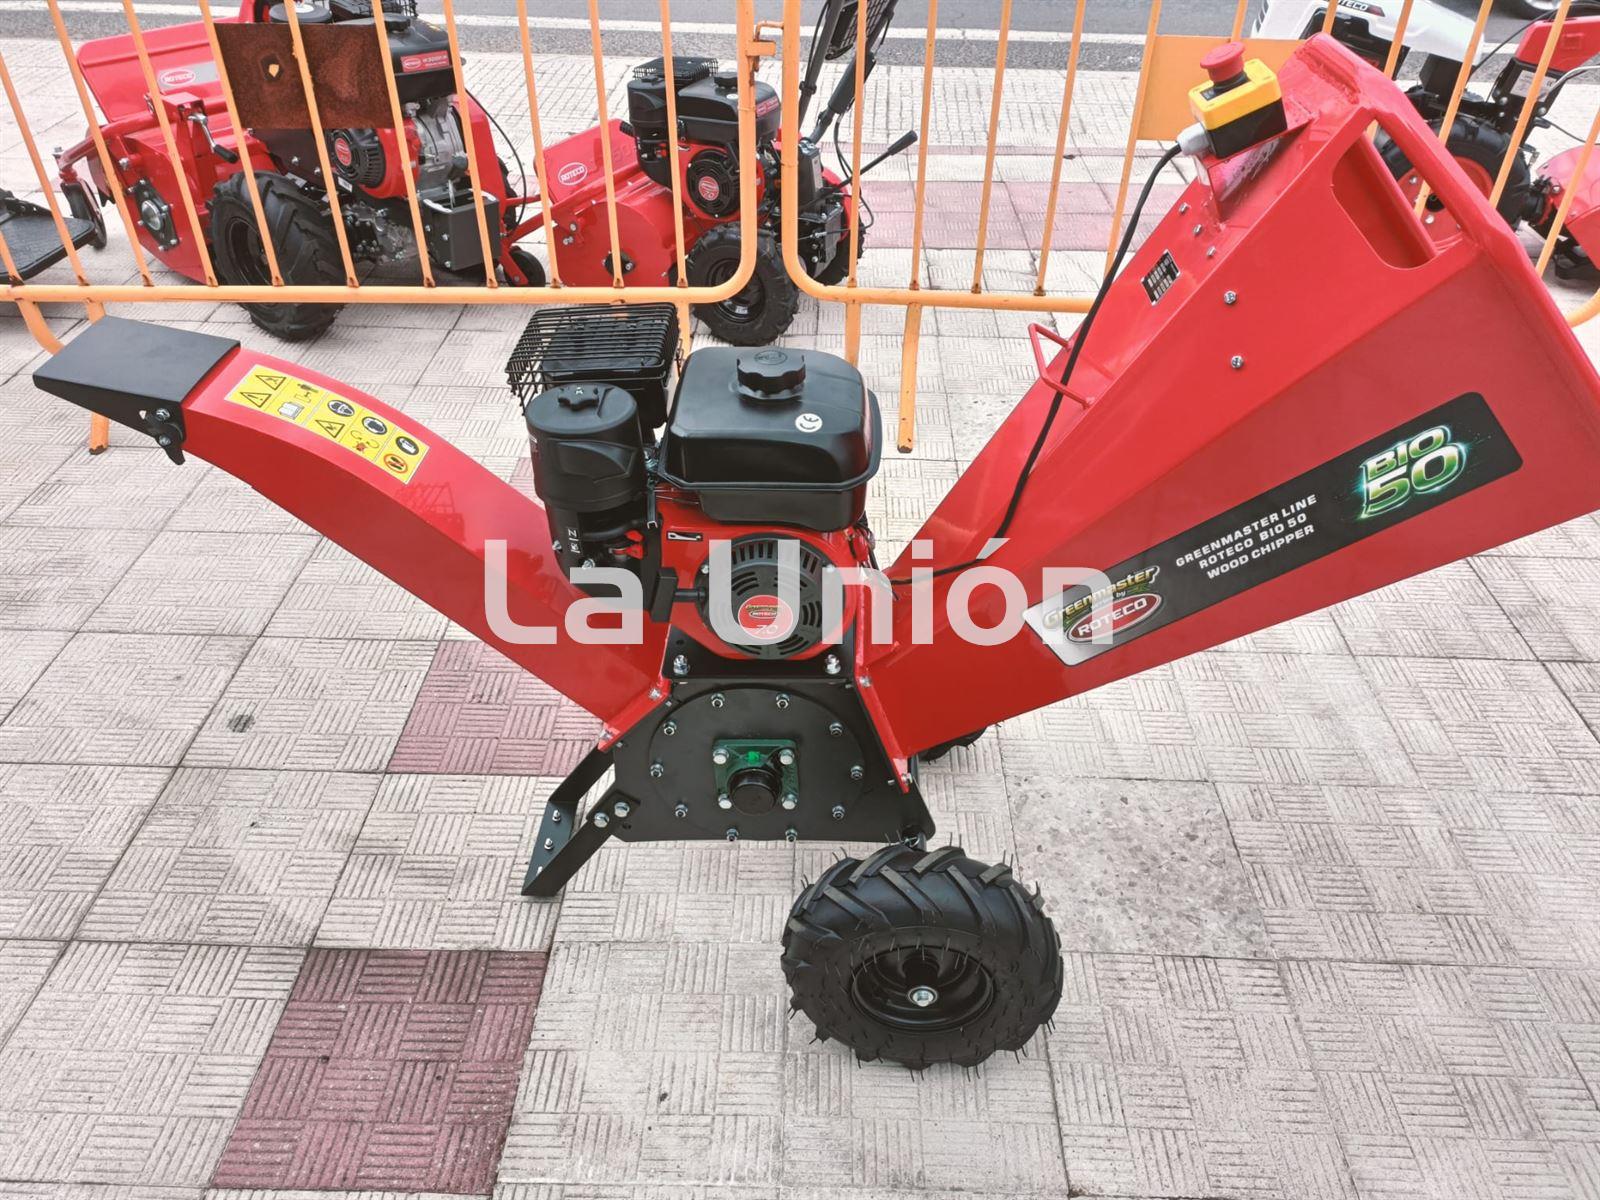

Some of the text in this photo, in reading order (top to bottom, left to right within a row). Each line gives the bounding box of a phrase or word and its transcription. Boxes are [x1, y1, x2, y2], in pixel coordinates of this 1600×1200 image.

[1364, 426, 1447, 480] BIO
[1366, 444, 1461, 514] 50
[1175, 494, 1318, 567] GREENMASTER LINE
[1199, 512, 1308, 570] ROTECO BIO 50
[1206, 524, 1315, 580] WOOD CHIPPER
[1043, 565, 1160, 630] Greenmaster
[1077, 597, 1148, 637] ROTECO
